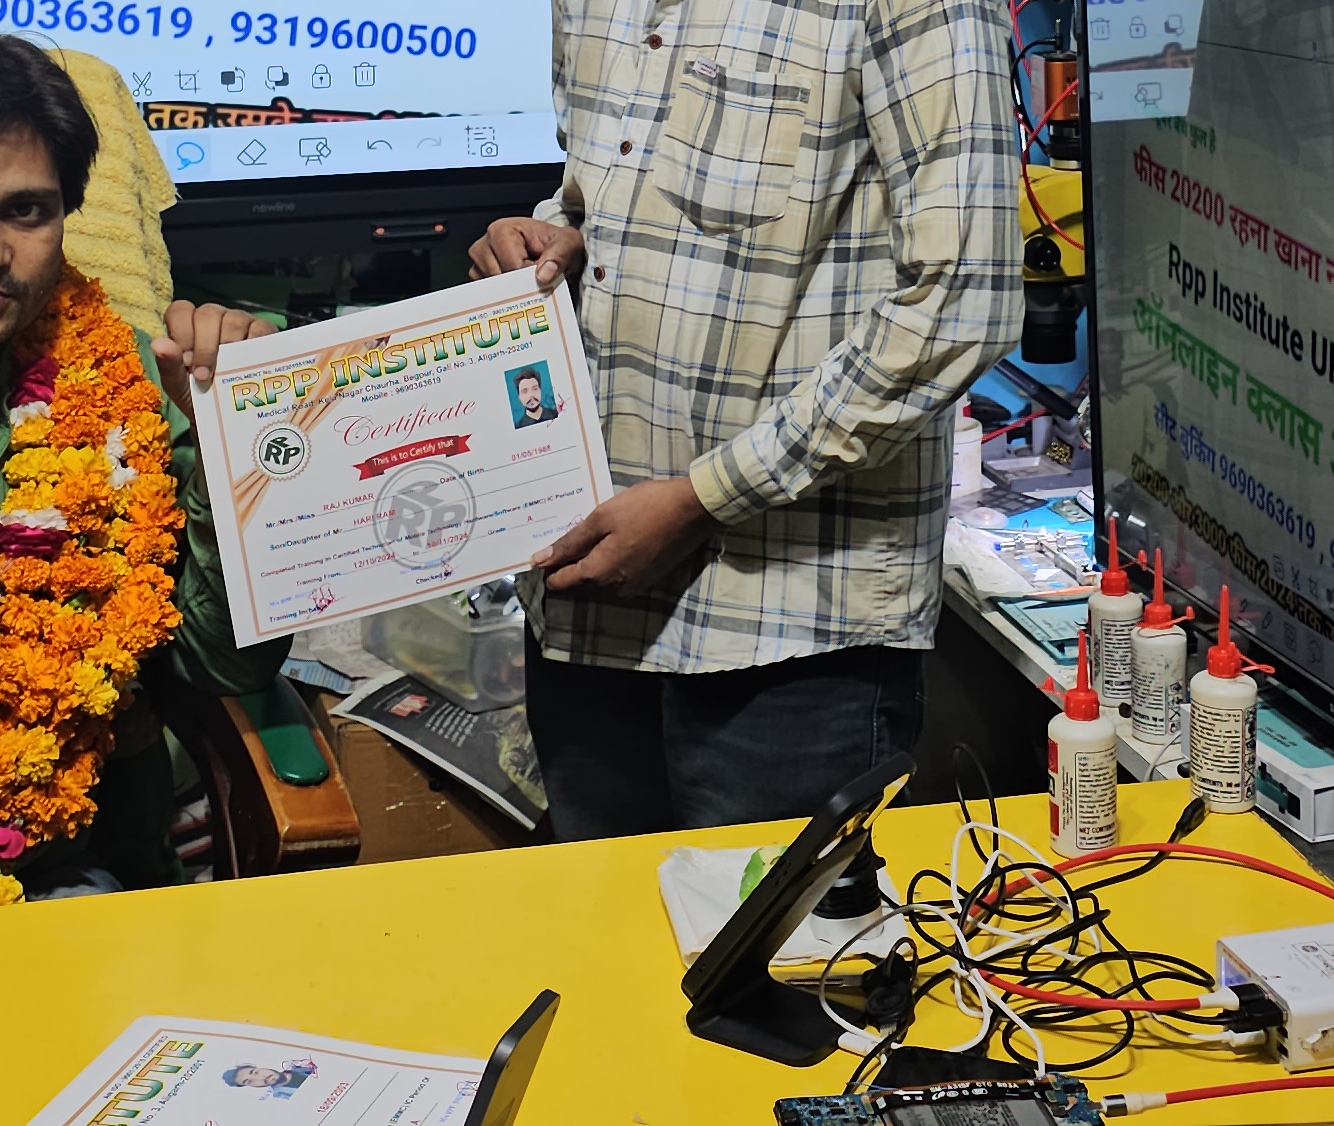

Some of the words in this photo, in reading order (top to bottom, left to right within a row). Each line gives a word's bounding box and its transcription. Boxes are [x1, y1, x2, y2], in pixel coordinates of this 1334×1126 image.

[229, 10, 479, 60] 9319600500
[1133, 143, 1167, 195] फीस
[1170, 169, 1225, 228] 20200
[1229, 204, 1269, 254] रहना
[1274, 228, 1322, 284] खाना
[1168, 240, 1207, 307] Rpp
[1212, 269, 1304, 363] Institute
[231, 366, 320, 412] RPP
[329, 304, 550, 389] INSTITUTE
[1133, 291, 1241, 406] ऑनलाइन
[1245, 372, 1323, 466] क्लास
[257, 406, 289, 420] Medical
[361, 390, 389, 404] Mobile
[333, 399, 476, 447] Certificate
[371, 456, 390, 467] This
[399, 450, 409, 460] to
[409, 442, 436, 459] Certify
[437, 438, 455, 450] that
[1154, 400, 1177, 442] सीट
[1219, 453, 1316, 550] 9690363619
[323, 500, 341, 512] RAJ
[342, 492, 375, 506] KUMAR
[353, 552, 396, 569] 12/10/2024
[1192, 507, 1229, 558] 3000
[1257, 558, 1297, 618] 2024
[269, 610, 298, 623] Training
[86, 1039, 205, 1126] TUTE
